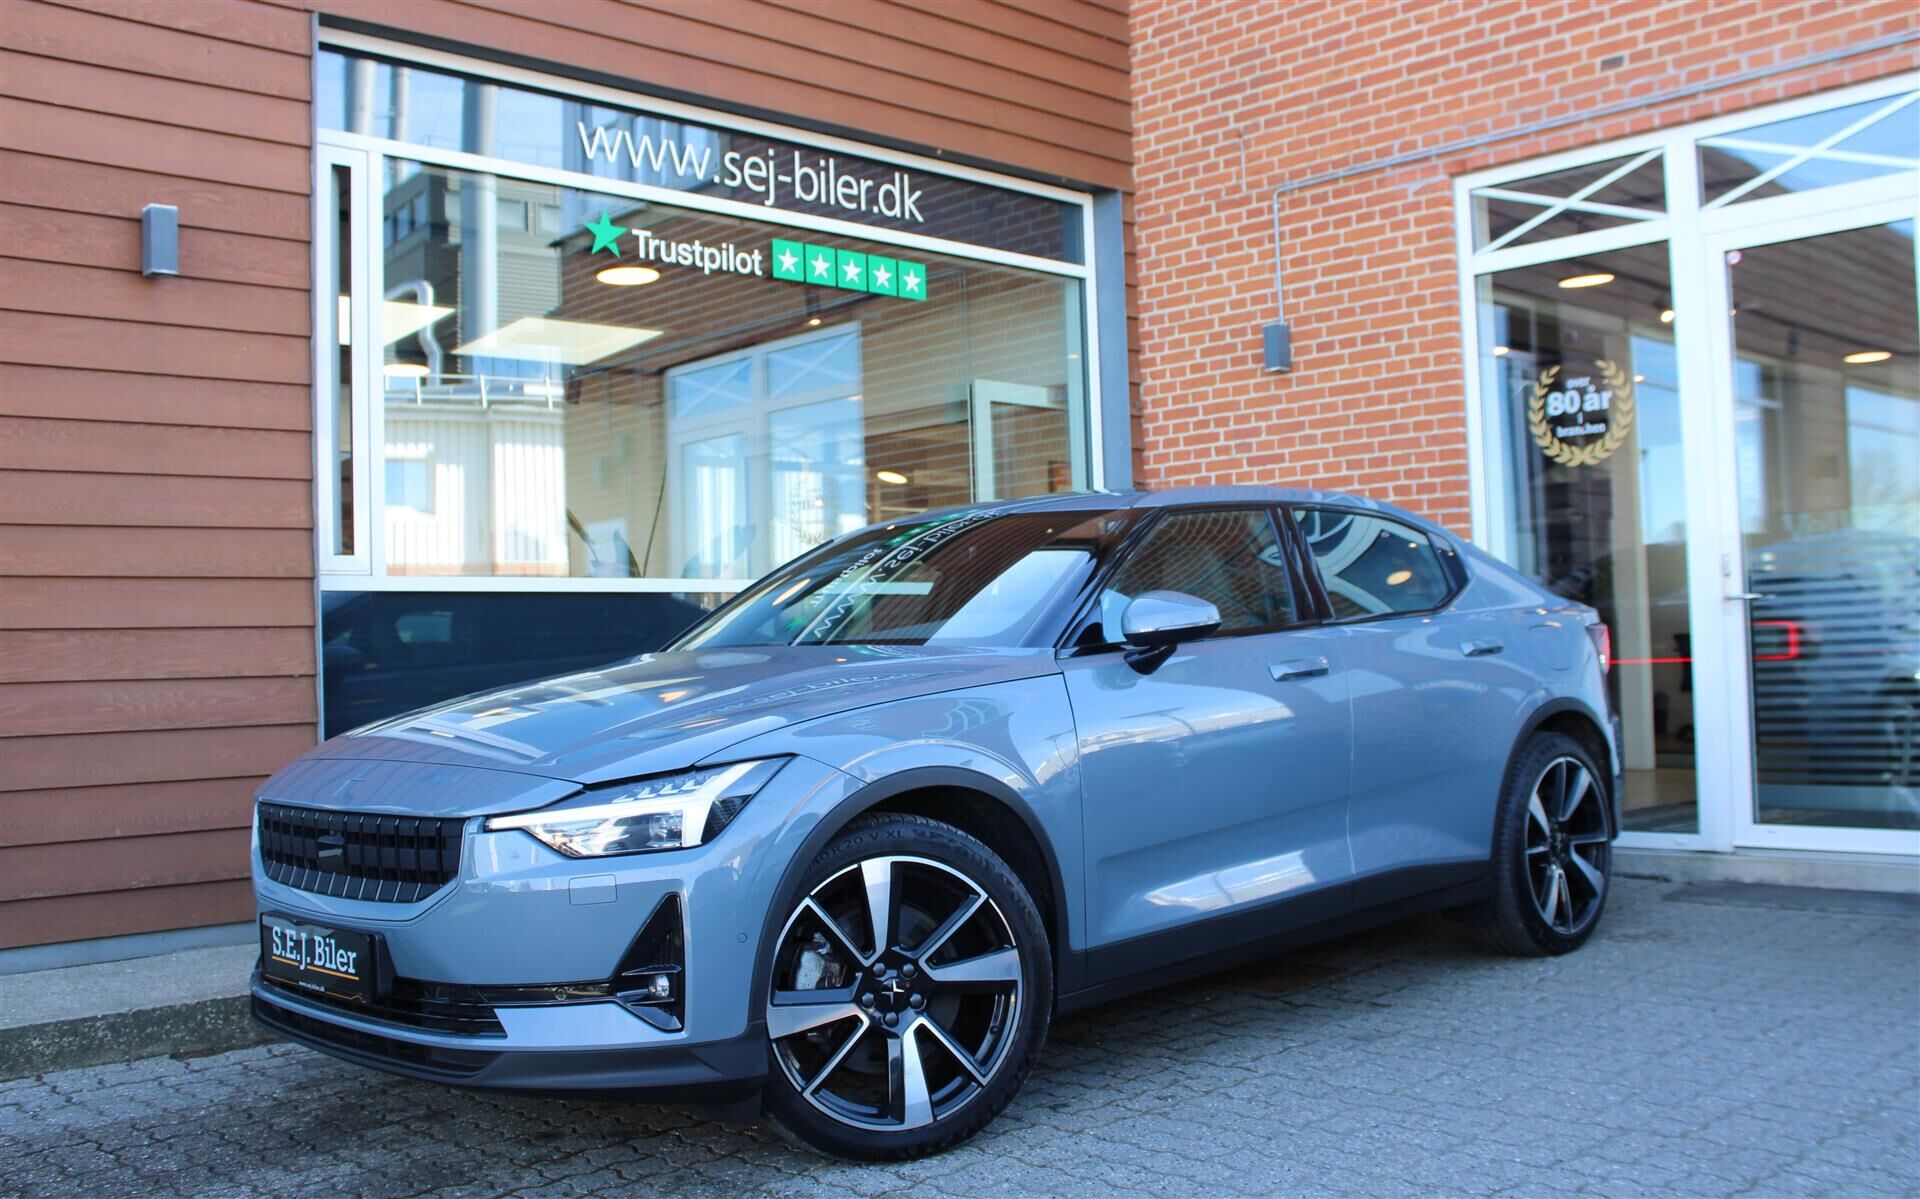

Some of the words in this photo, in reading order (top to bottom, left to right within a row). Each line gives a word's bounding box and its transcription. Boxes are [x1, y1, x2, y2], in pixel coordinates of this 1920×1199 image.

[578, 121, 925, 223] www.sej-biler.dk
[631, 228, 763, 276] Trustpilot
[1546, 390, 1581, 417] 80
[1582, 384, 1613, 412] år
[272, 926, 311, 970] S.E.J.
[313, 935, 357, 974] Biler
